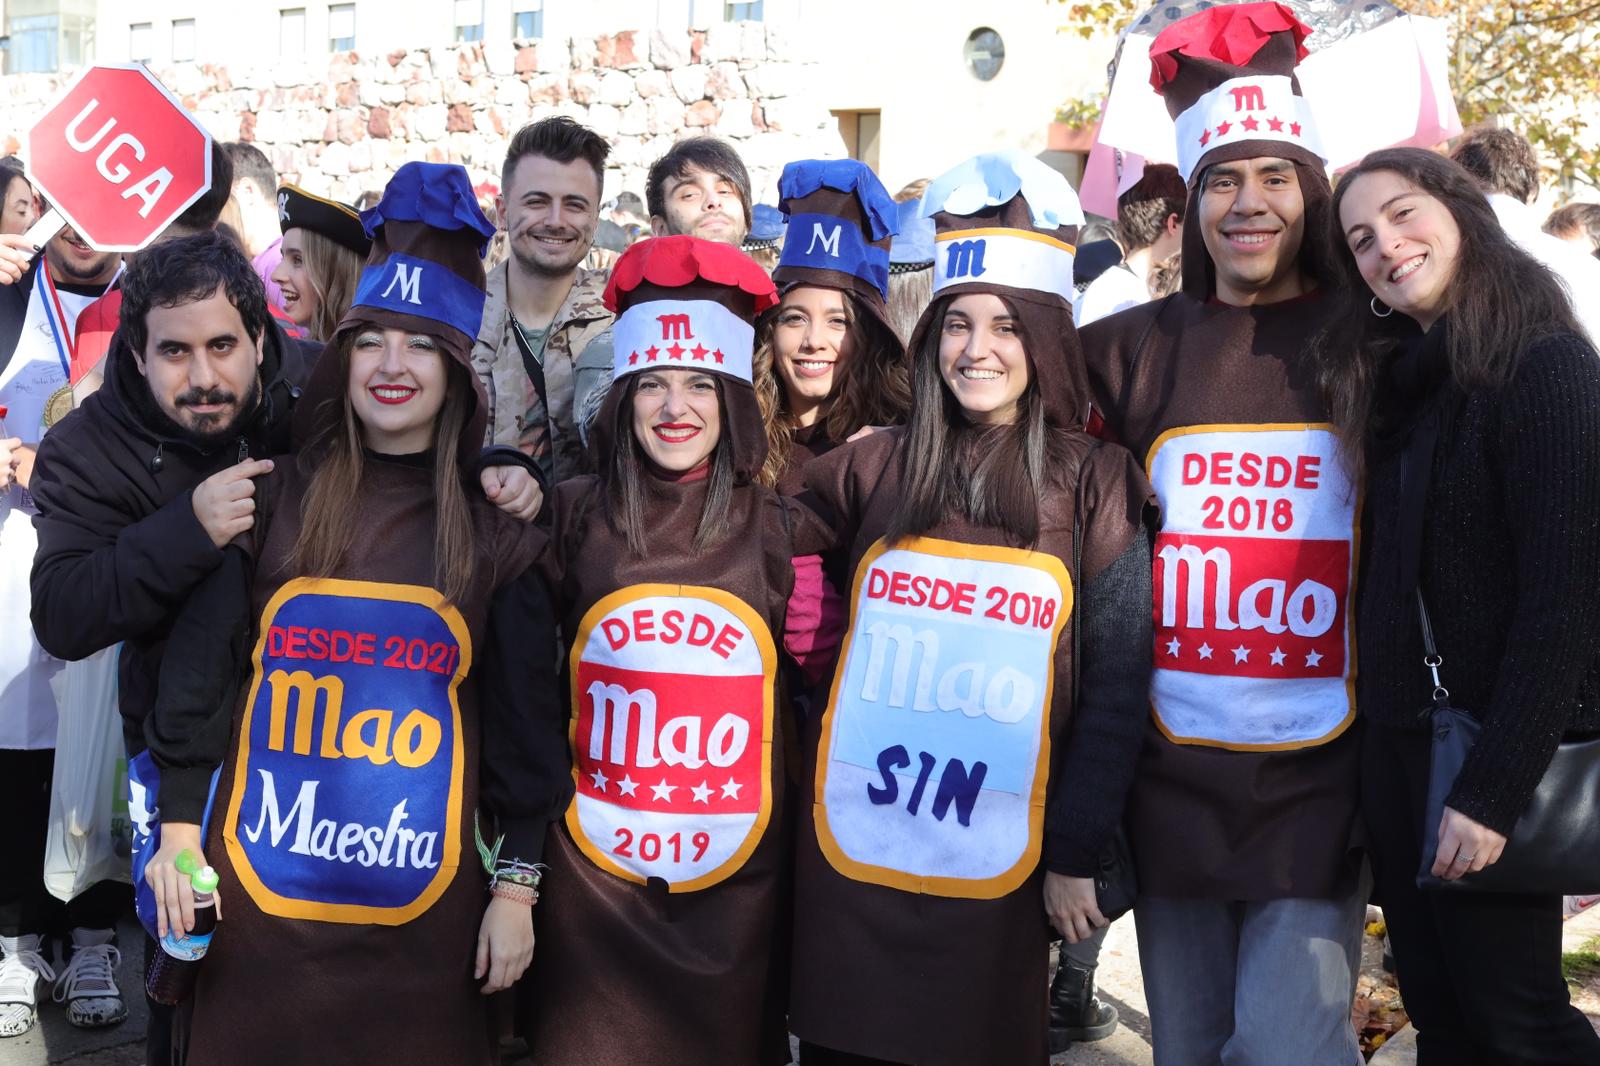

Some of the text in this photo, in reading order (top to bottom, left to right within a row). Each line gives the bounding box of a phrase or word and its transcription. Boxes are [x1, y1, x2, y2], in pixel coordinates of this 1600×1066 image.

[64, 97, 174, 220] UGA
[805, 222, 842, 258] M
[380, 262, 423, 305] M
[1181, 452, 1321, 490] DESDE
[1202, 496, 1294, 532] 2018
[867, 566, 1057, 630] DESDE 2018
[267, 624, 459, 676] DESDE 2021
[601, 609, 745, 660] DESDE
[867, 744, 989, 827] SIN
[243, 768, 439, 869] Maestra
[613, 827, 711, 863] 2019
